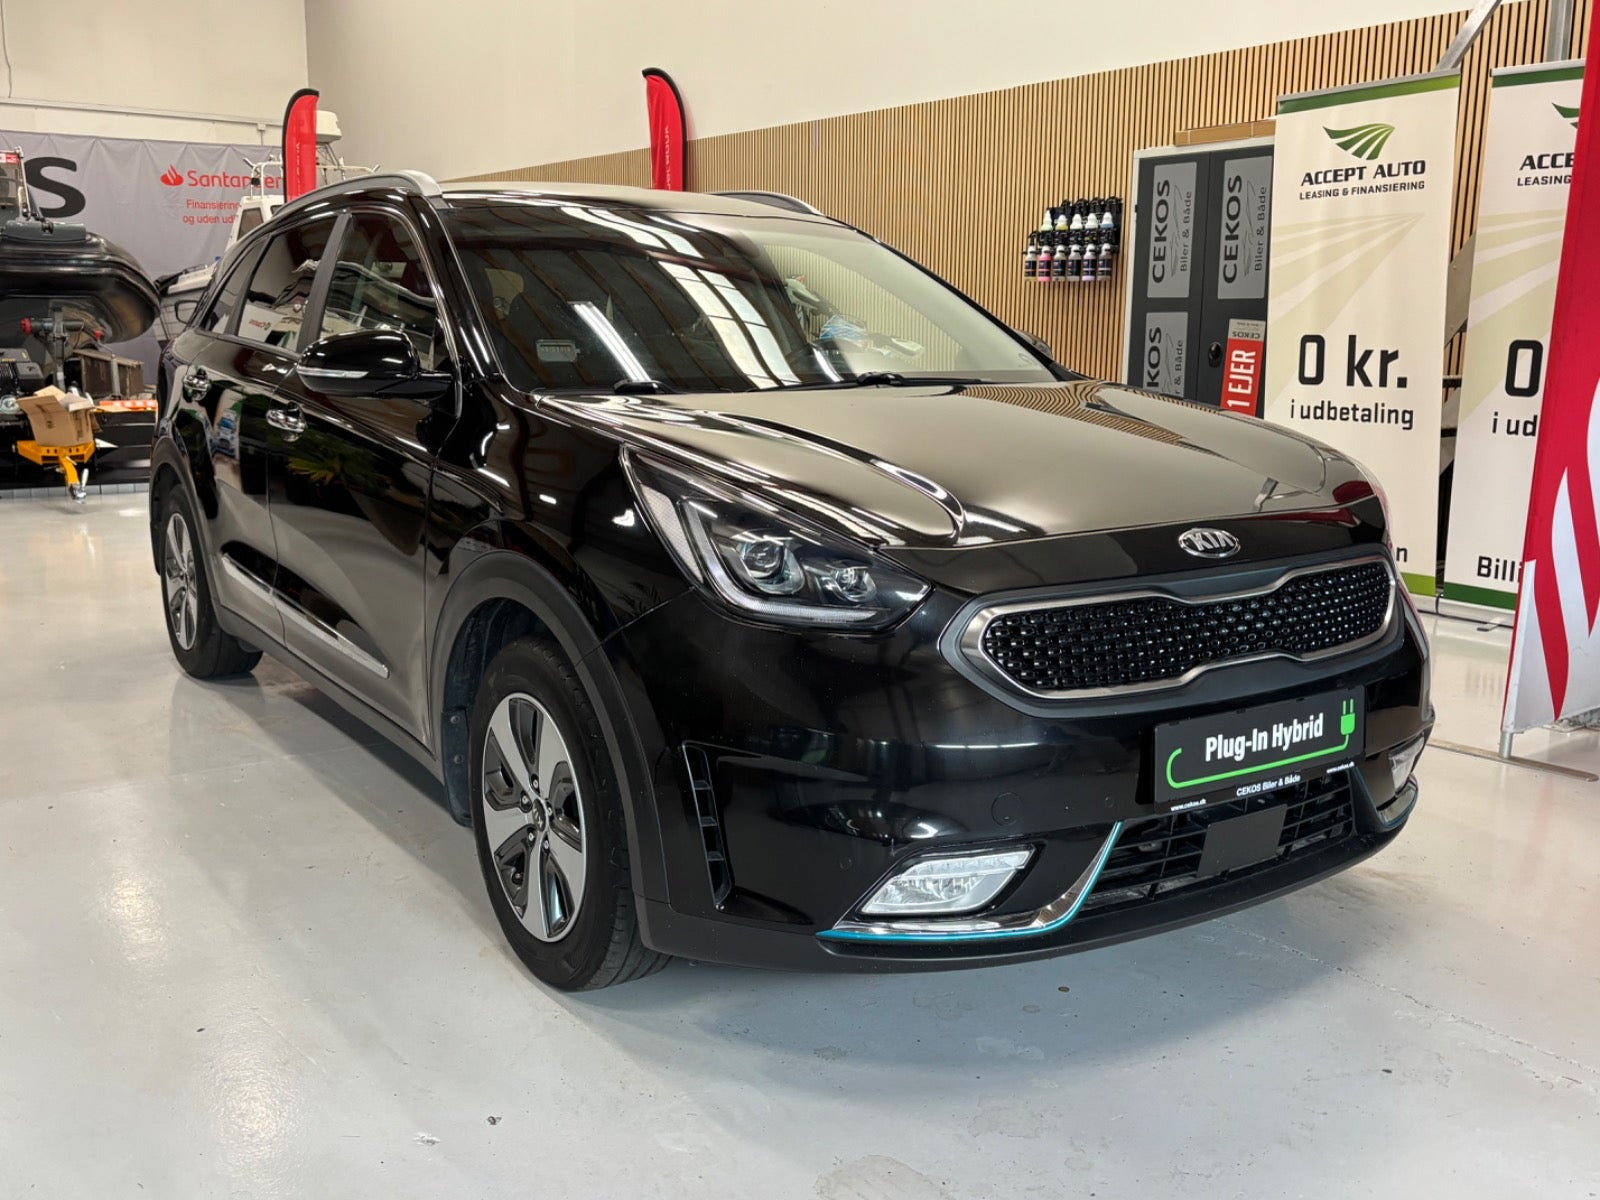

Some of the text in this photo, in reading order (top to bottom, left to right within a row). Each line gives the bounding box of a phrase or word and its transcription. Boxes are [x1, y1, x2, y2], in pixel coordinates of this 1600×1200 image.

[187, 170, 282, 189] Santaner
[1300, 160, 1426, 186] ACCEPT AUTO
[1517, 175, 1572, 186] LEASING
[1299, 180, 1425, 200] LEASING & FINANSIERING
[1152, 180, 1170, 283] CEKOS
[1180, 191, 1192, 272] Biler & Både
[1223, 175, 1242, 284] CEKOS
[1254, 187, 1267, 271] Biler & Både
[1228, 349, 1256, 395] EJER
[1298, 334, 1408, 388] 0 kr.
[1505, 339, 1544, 398] 0
[1227, 399, 1250, 407] 1
[1290, 398, 1414, 430] i udbetaling
[1492, 411, 1499, 434] i
[1183, 530, 1235, 552] KIA
[1205, 712, 1324, 762] Plug-In Hybrid
[1236, 782, 1262, 797] CEKOS
